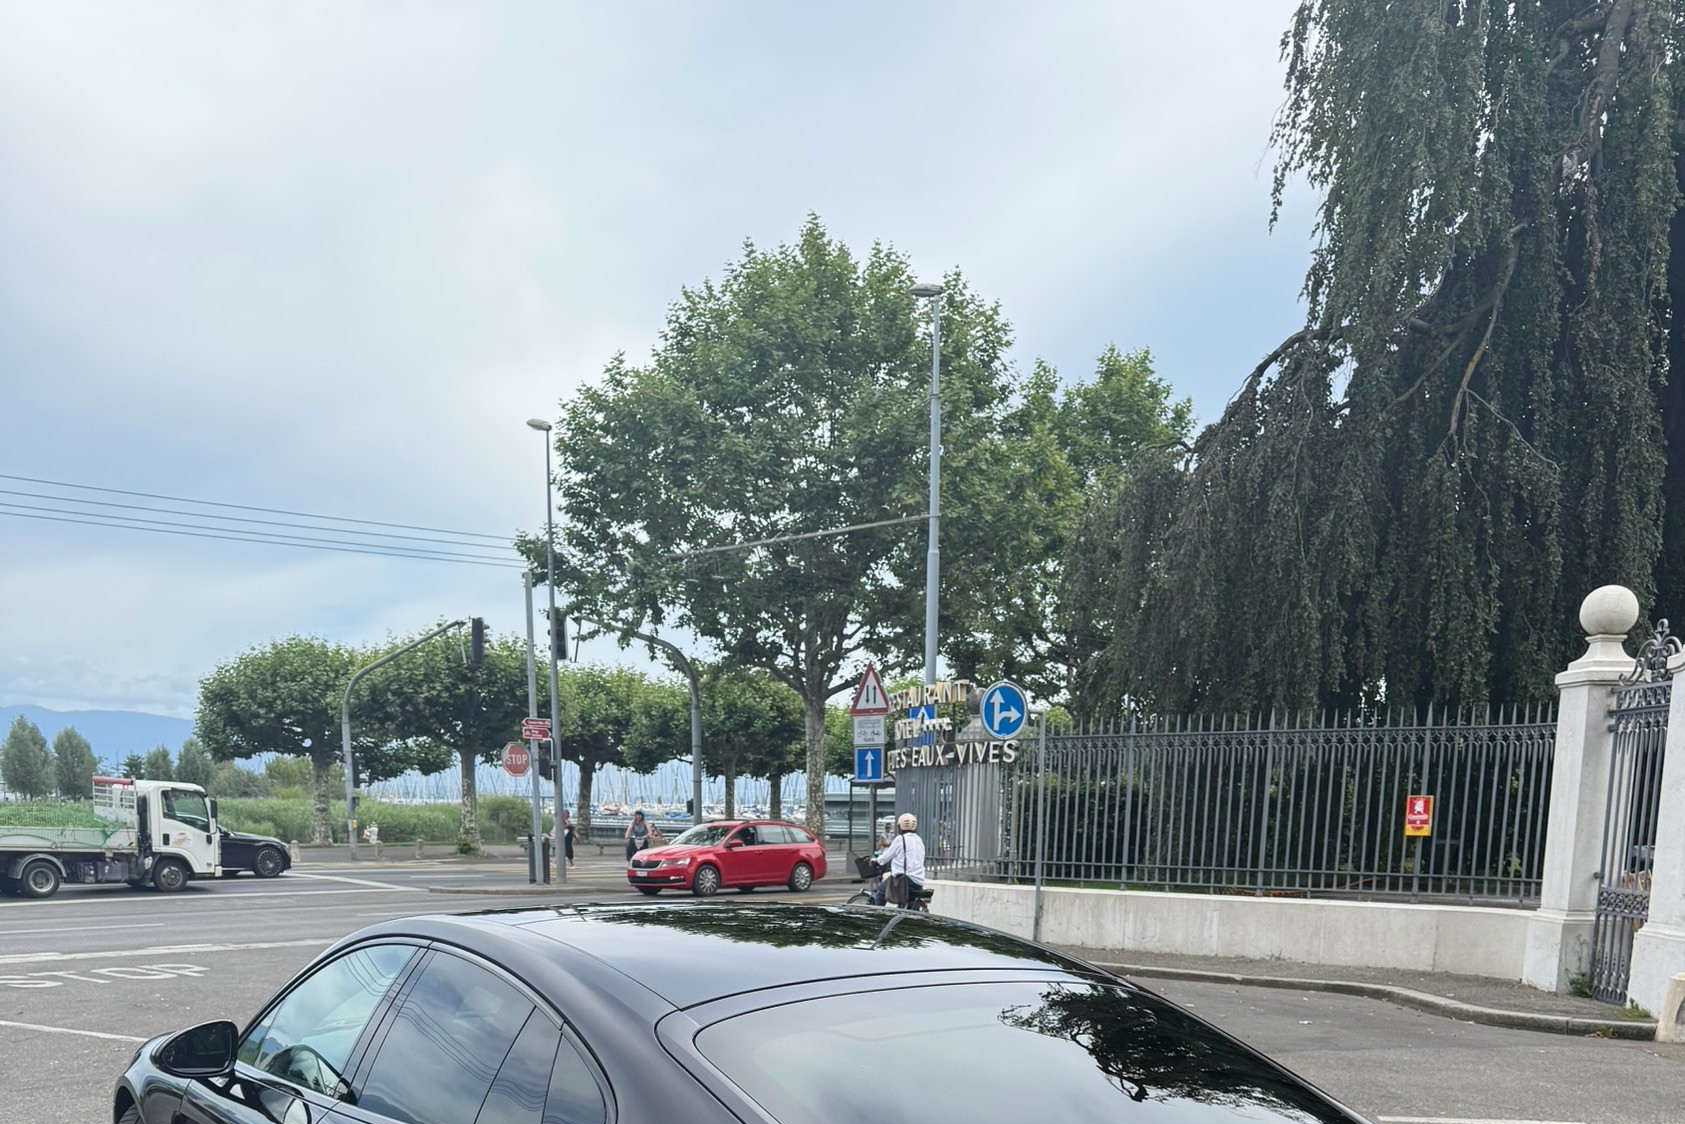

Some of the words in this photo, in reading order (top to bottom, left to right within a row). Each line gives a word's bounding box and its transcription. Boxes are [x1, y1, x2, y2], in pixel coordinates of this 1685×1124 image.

[506, 754, 528, 765] STOP
[911, 740, 1017, 767] EAUX-VIVES
[0, 963, 210, 988] STOP
